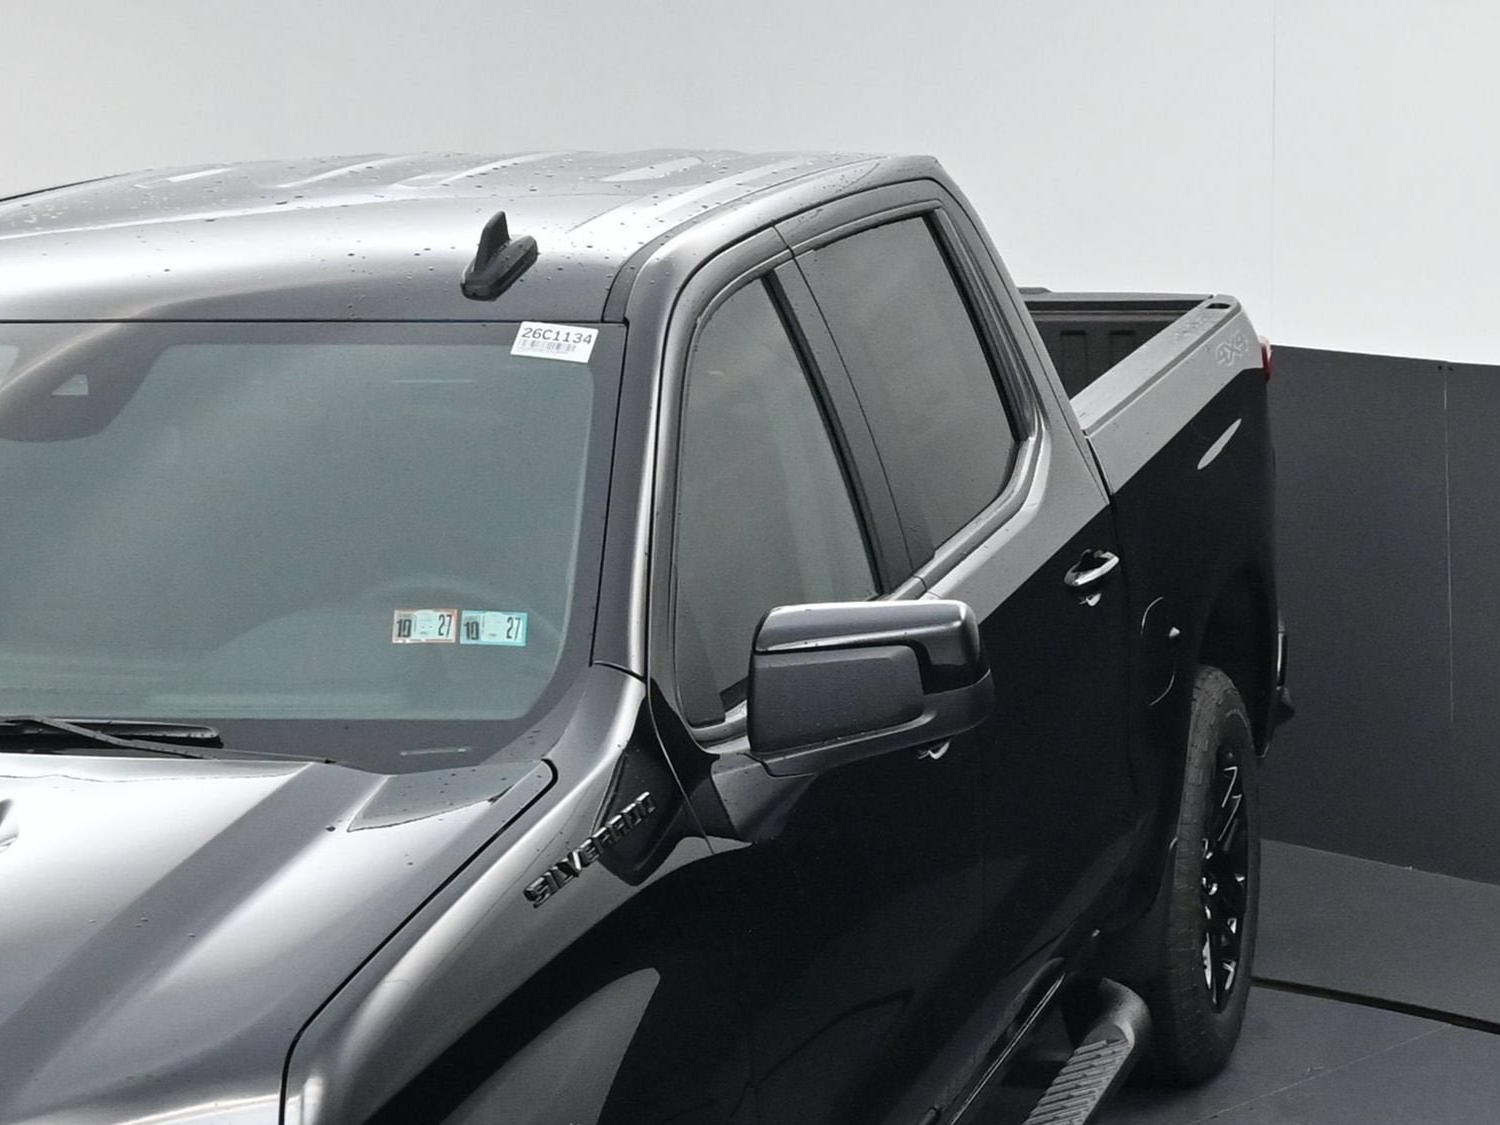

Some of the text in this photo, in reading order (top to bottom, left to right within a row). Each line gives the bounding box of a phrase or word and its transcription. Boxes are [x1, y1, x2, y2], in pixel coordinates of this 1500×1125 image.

[521, 327, 593, 344] 26C1134
[438, 614, 453, 638] 27
[506, 616, 521, 641] 27
[523, 791, 657, 909] SILVERADO
